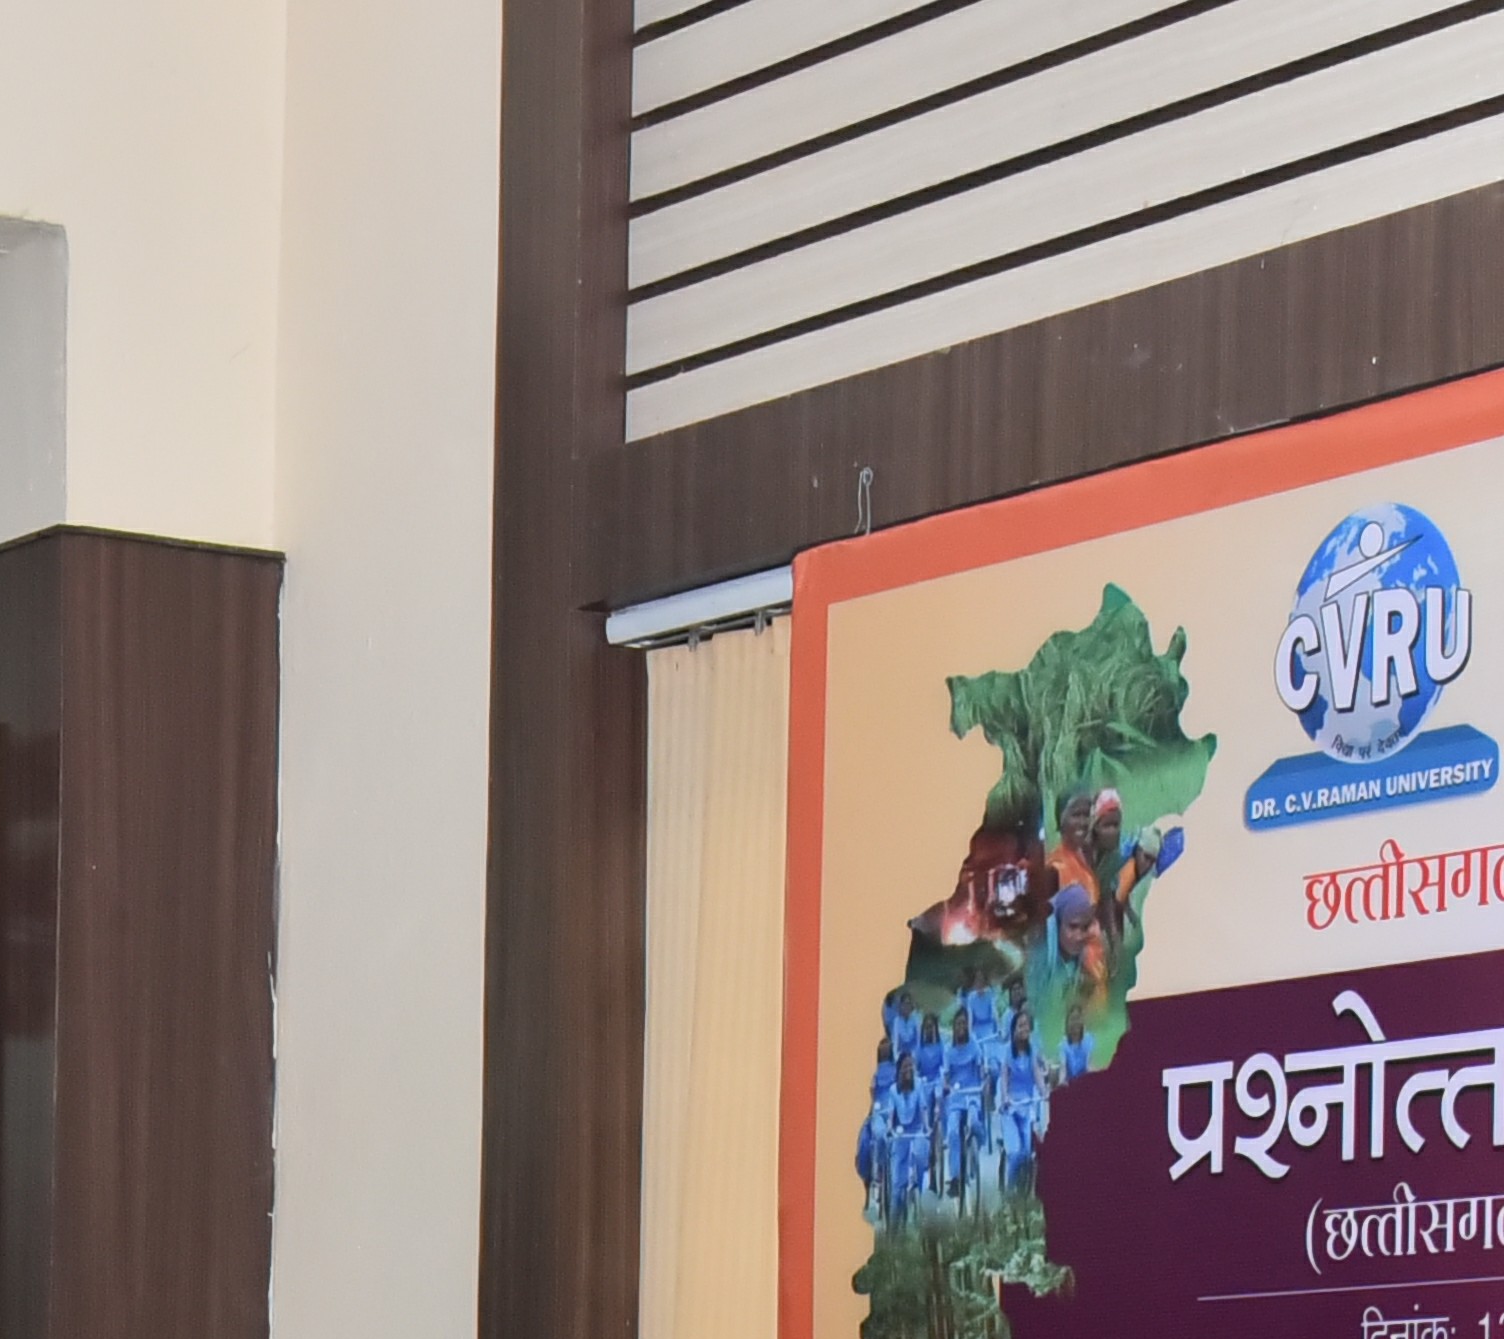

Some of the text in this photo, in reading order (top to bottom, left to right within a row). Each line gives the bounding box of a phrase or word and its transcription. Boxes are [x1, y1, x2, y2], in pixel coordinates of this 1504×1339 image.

[1274, 586, 1472, 714] CVRU
[1251, 758, 1493, 820] DR. C.V.RAMAN UNIVERSITY
